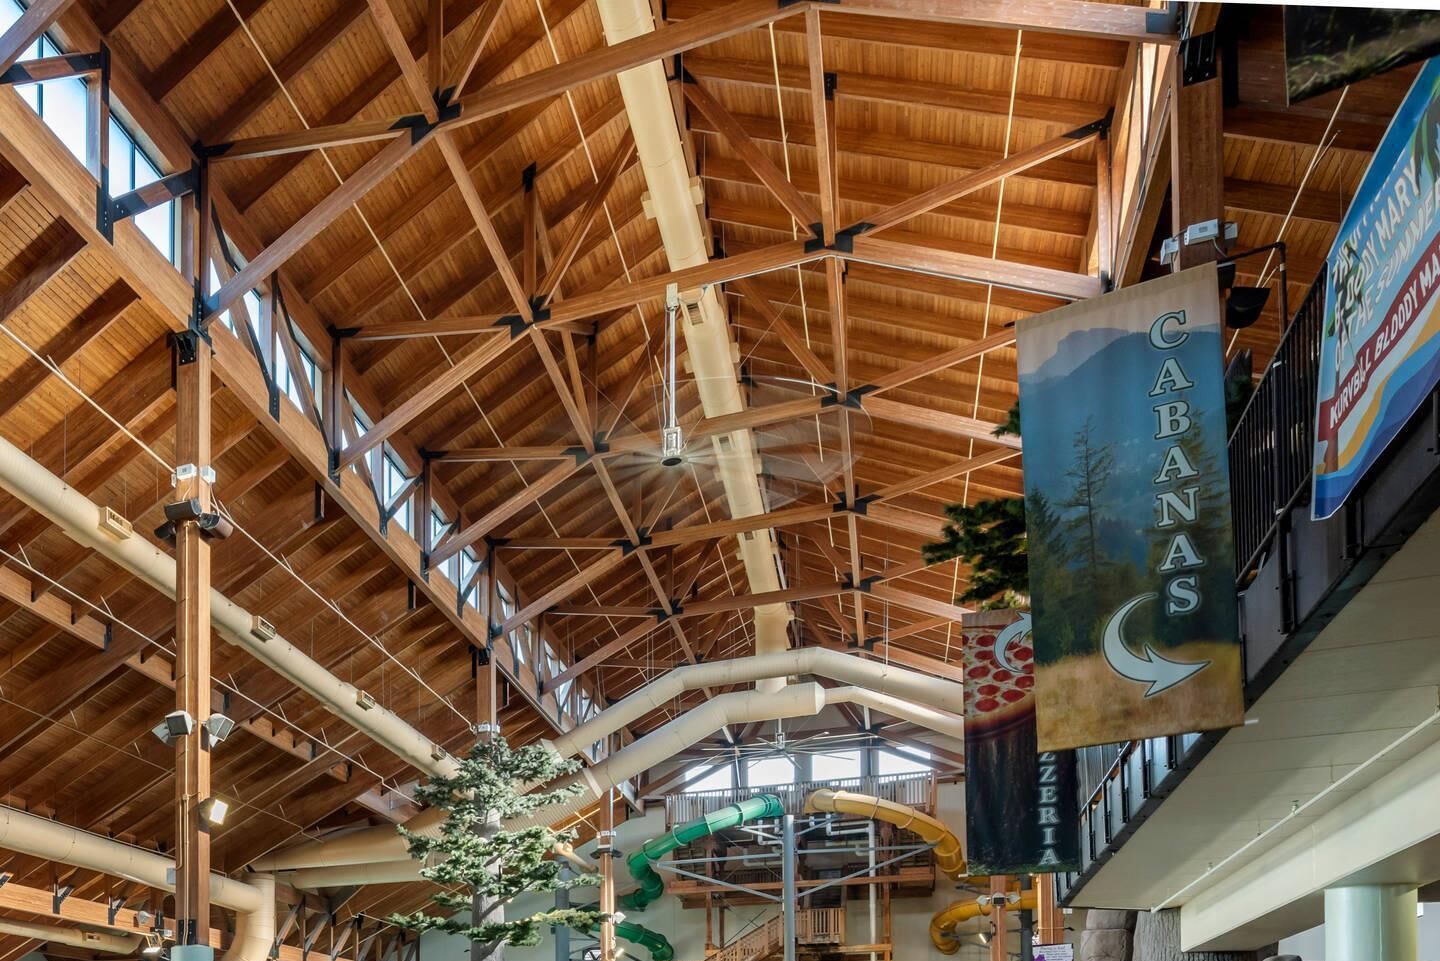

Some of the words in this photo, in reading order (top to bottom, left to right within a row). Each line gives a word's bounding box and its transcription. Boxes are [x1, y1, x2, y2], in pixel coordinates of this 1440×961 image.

[1375, 156, 1420, 253] MARY
[1330, 347, 1372, 428] KURVBALL
[1374, 279, 1417, 361] BLOODY
[1419, 244, 1440, 298] MA
[1346, 282, 1374, 338] THE
[1148, 310, 1205, 616] CABANAS
